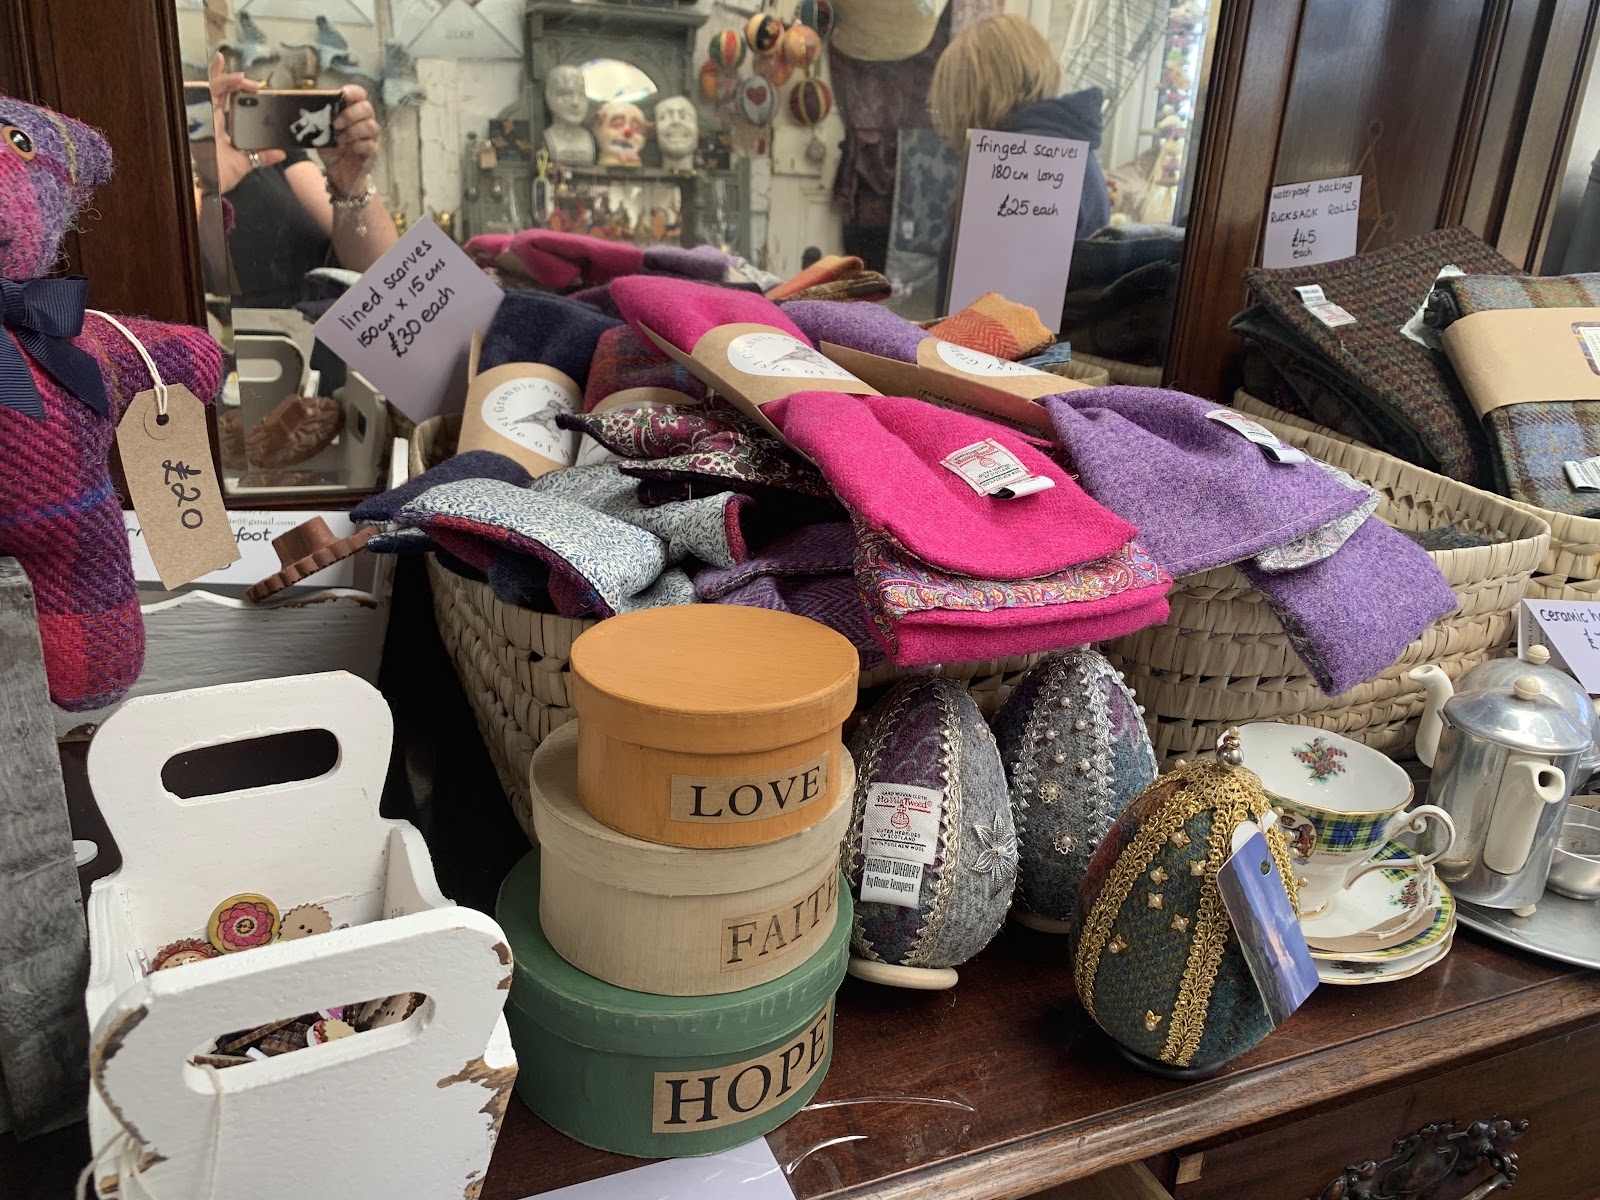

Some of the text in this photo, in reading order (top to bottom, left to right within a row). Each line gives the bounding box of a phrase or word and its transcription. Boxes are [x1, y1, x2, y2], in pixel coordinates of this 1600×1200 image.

[976, 135, 1078, 161] fringed scarves
[1038, 168, 1064, 189] long
[1273, 180, 1353, 199] waterproof backing
[997, 193, 1058, 217] £25 each
[1270, 200, 1357, 223] RUCKSACK ROLLS
[1291, 228, 1316, 248] £45
[1292, 247, 1312, 259] each
[338, 239, 432, 331] lined scarves
[396, 298, 408, 310] x
[388, 286, 456, 358] £30 each
[162, 459, 204, 530] £20
[229, 515, 297, 527] ie@gmail.com
[1540, 608, 1589, 623] ceramic
[689, 765, 822, 819] LOVE
[865, 857, 921, 879] HEBRIDES TWEEDERY
[865, 874, 915, 893] by Annie Tempest
[726, 864, 839, 965] FAITH
[664, 1012, 828, 1125] HOPE
